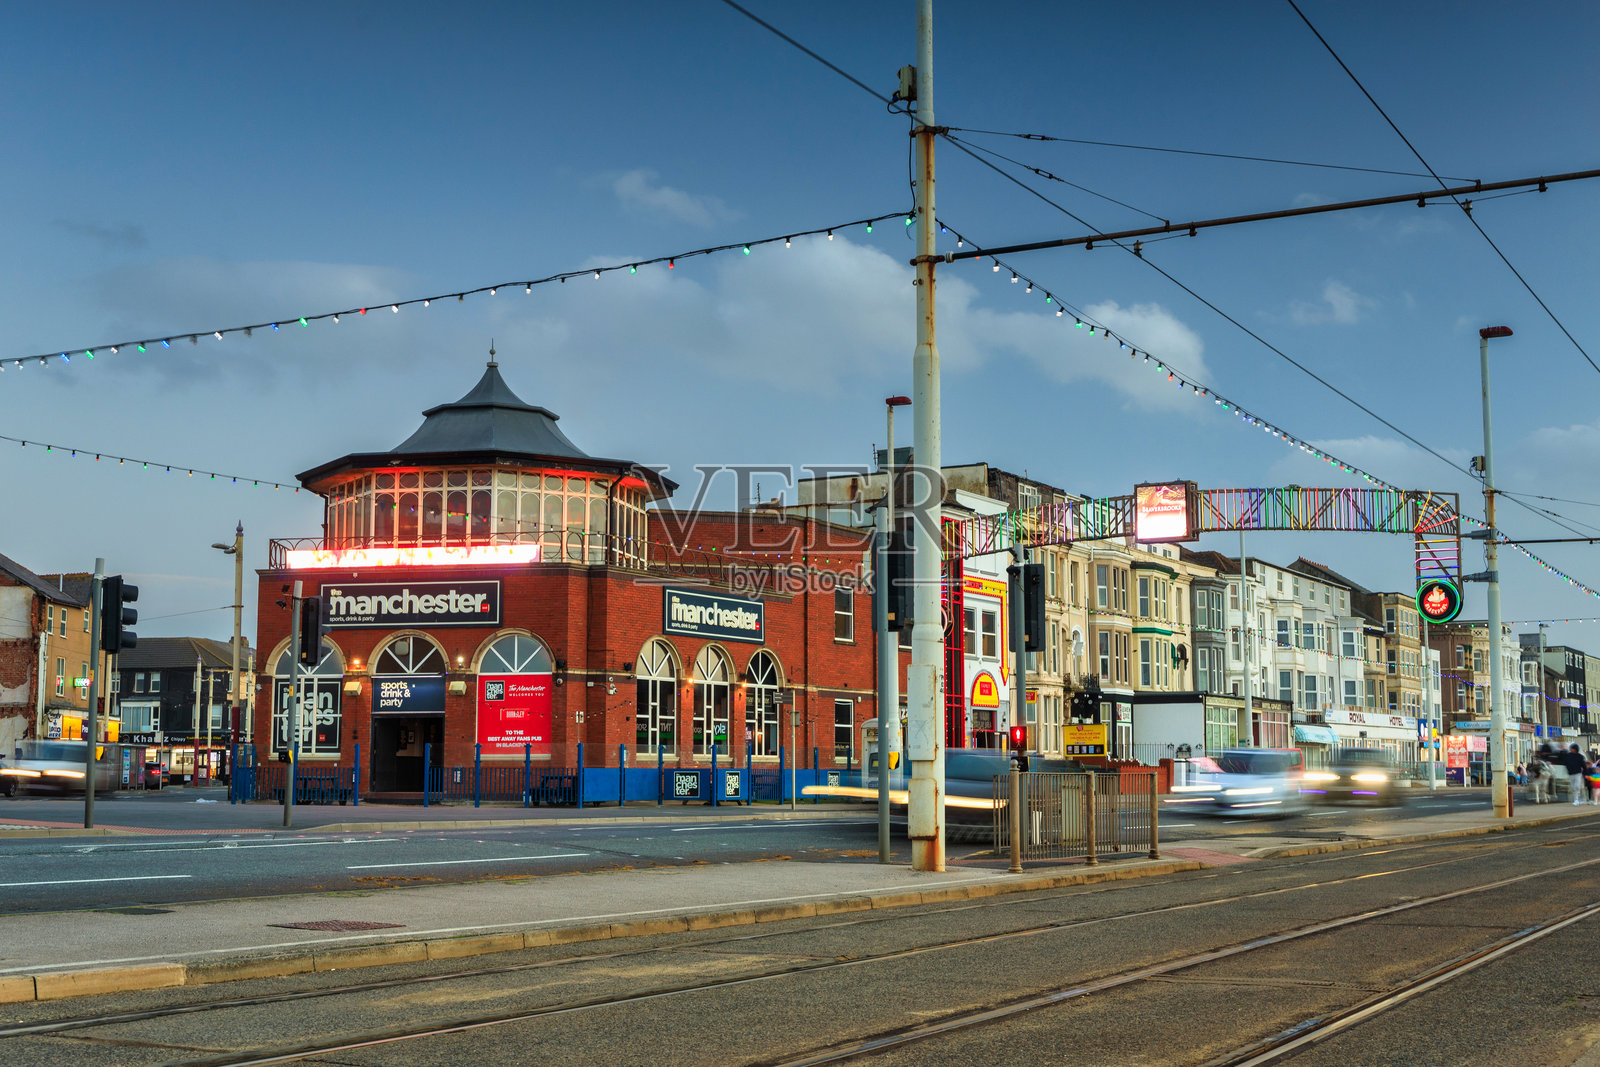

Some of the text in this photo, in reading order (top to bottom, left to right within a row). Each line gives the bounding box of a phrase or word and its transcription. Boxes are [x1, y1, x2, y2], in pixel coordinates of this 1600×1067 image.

[330, 588, 342, 596] the
[330, 589, 487, 615] manchester
[672, 602, 758, 630] manchester
[381, 681, 408, 690] sports
[381, 689, 411, 698] drink &
[380, 698, 403, 708] party
[1349, 713, 1366, 724] ROYAL
[1389, 716, 1404, 727] HOTEL
[676, 781, 698, 789] ches
